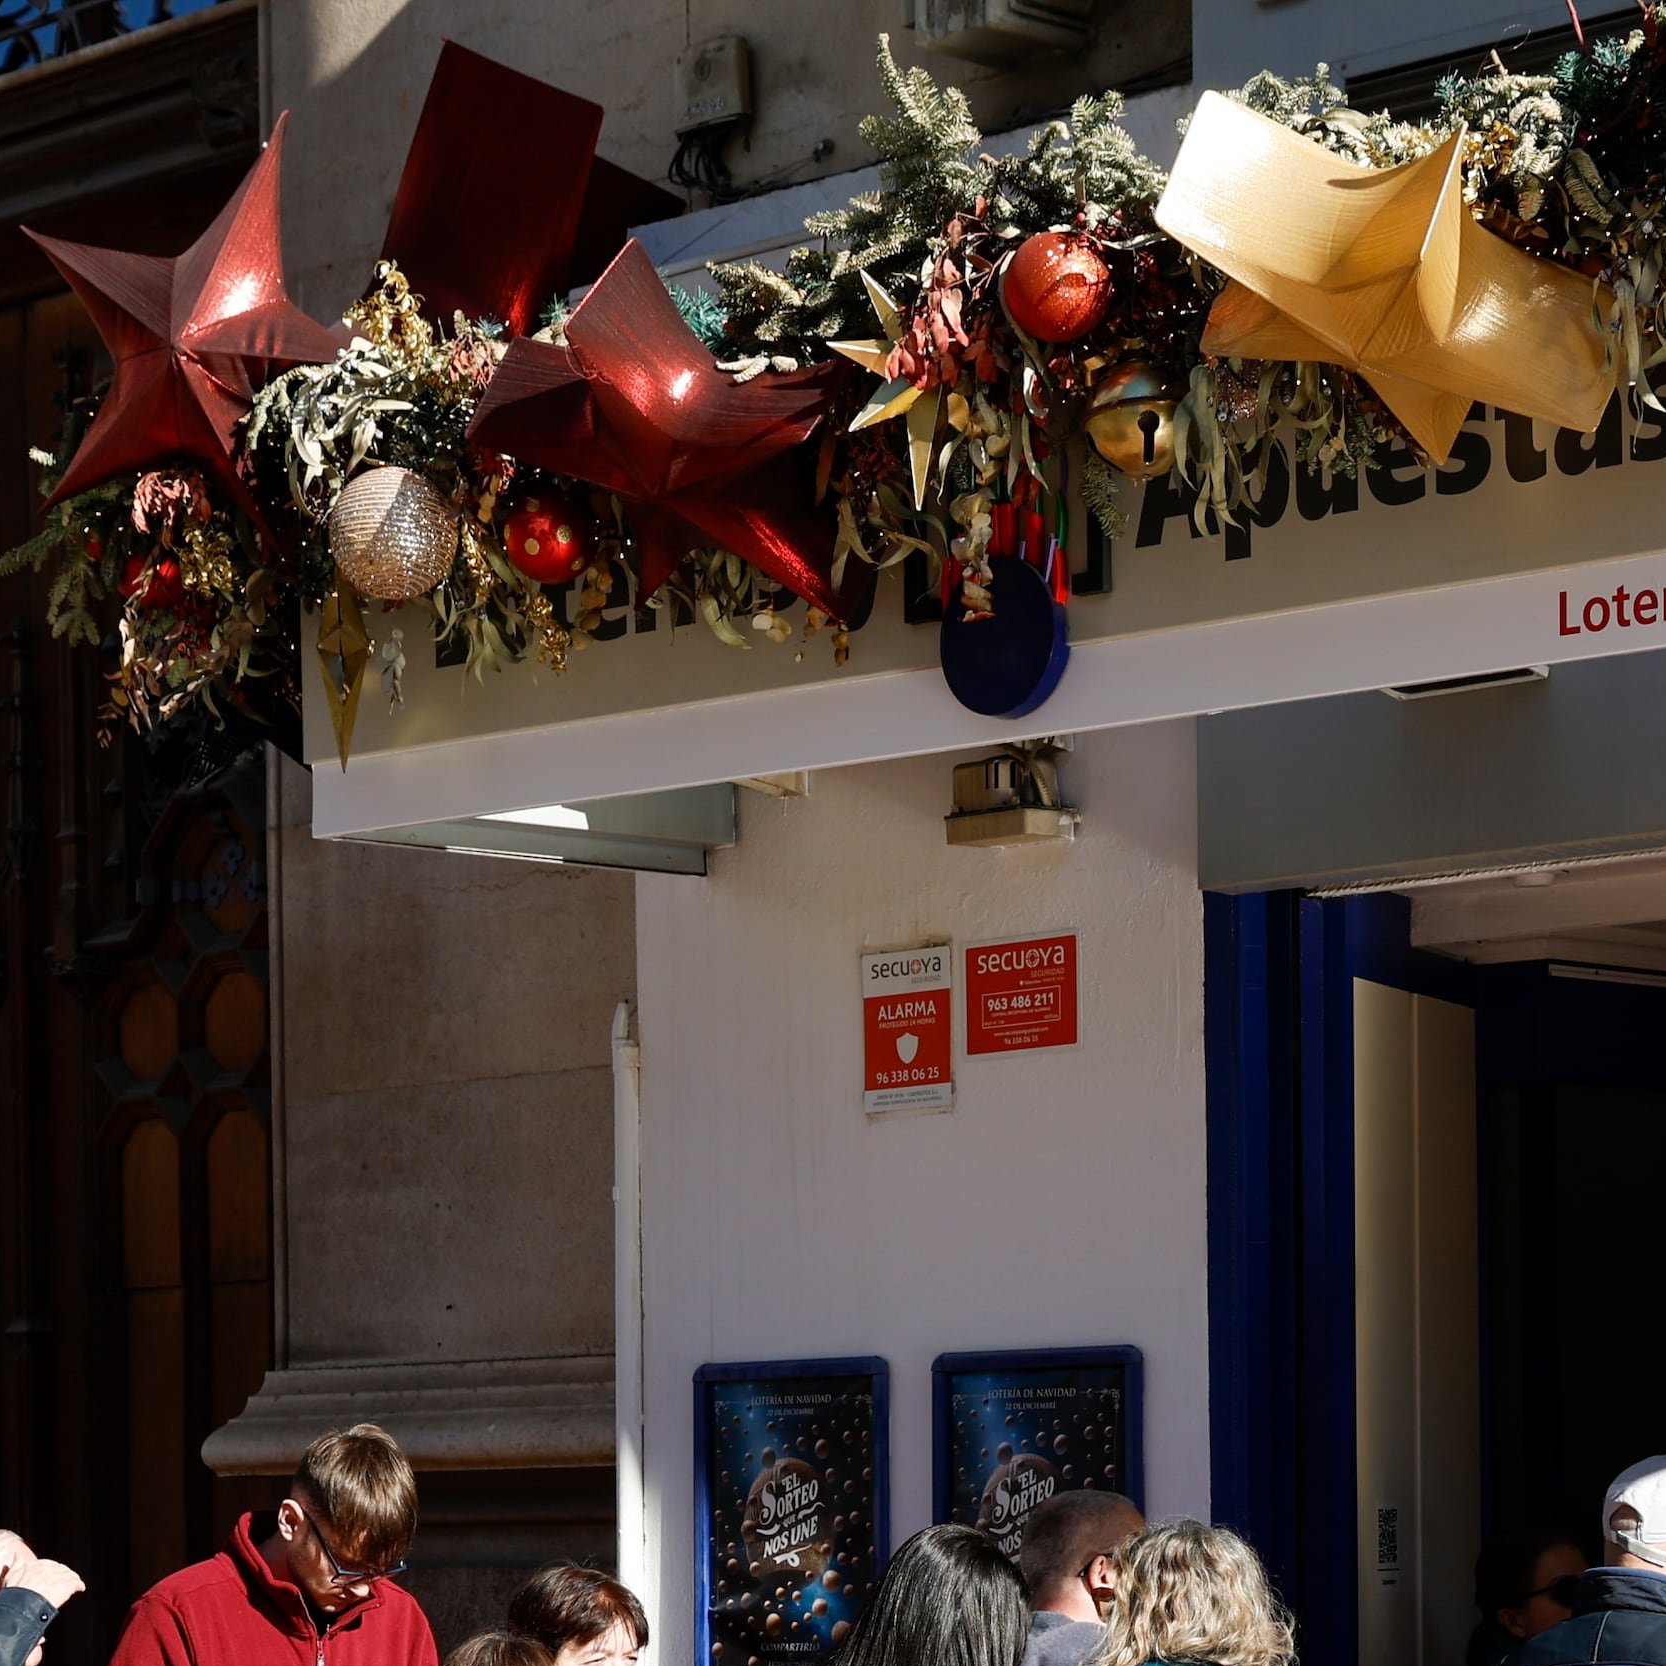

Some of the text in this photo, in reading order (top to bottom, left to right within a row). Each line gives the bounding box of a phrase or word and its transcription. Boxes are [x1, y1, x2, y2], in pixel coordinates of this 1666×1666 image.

[877, 1000, 936, 1021] ALARMA
[987, 992, 1054, 1012] 963 486 211
[876, 1066, 940, 1084] 96 338 06 25
[783, 1395, 795, 1404] DE
[796, 1394, 832, 1404] NAVIDAD
[1023, 1388, 1034, 1398] DE
[1036, 1387, 1076, 1398] NAVIDAD
[782, 1472, 801, 1491] EL
[1018, 1468, 1038, 1491] EL
[763, 1515, 819, 1559] NOS UNE
[761, 1641, 821, 1652] COMPARTIRLO
